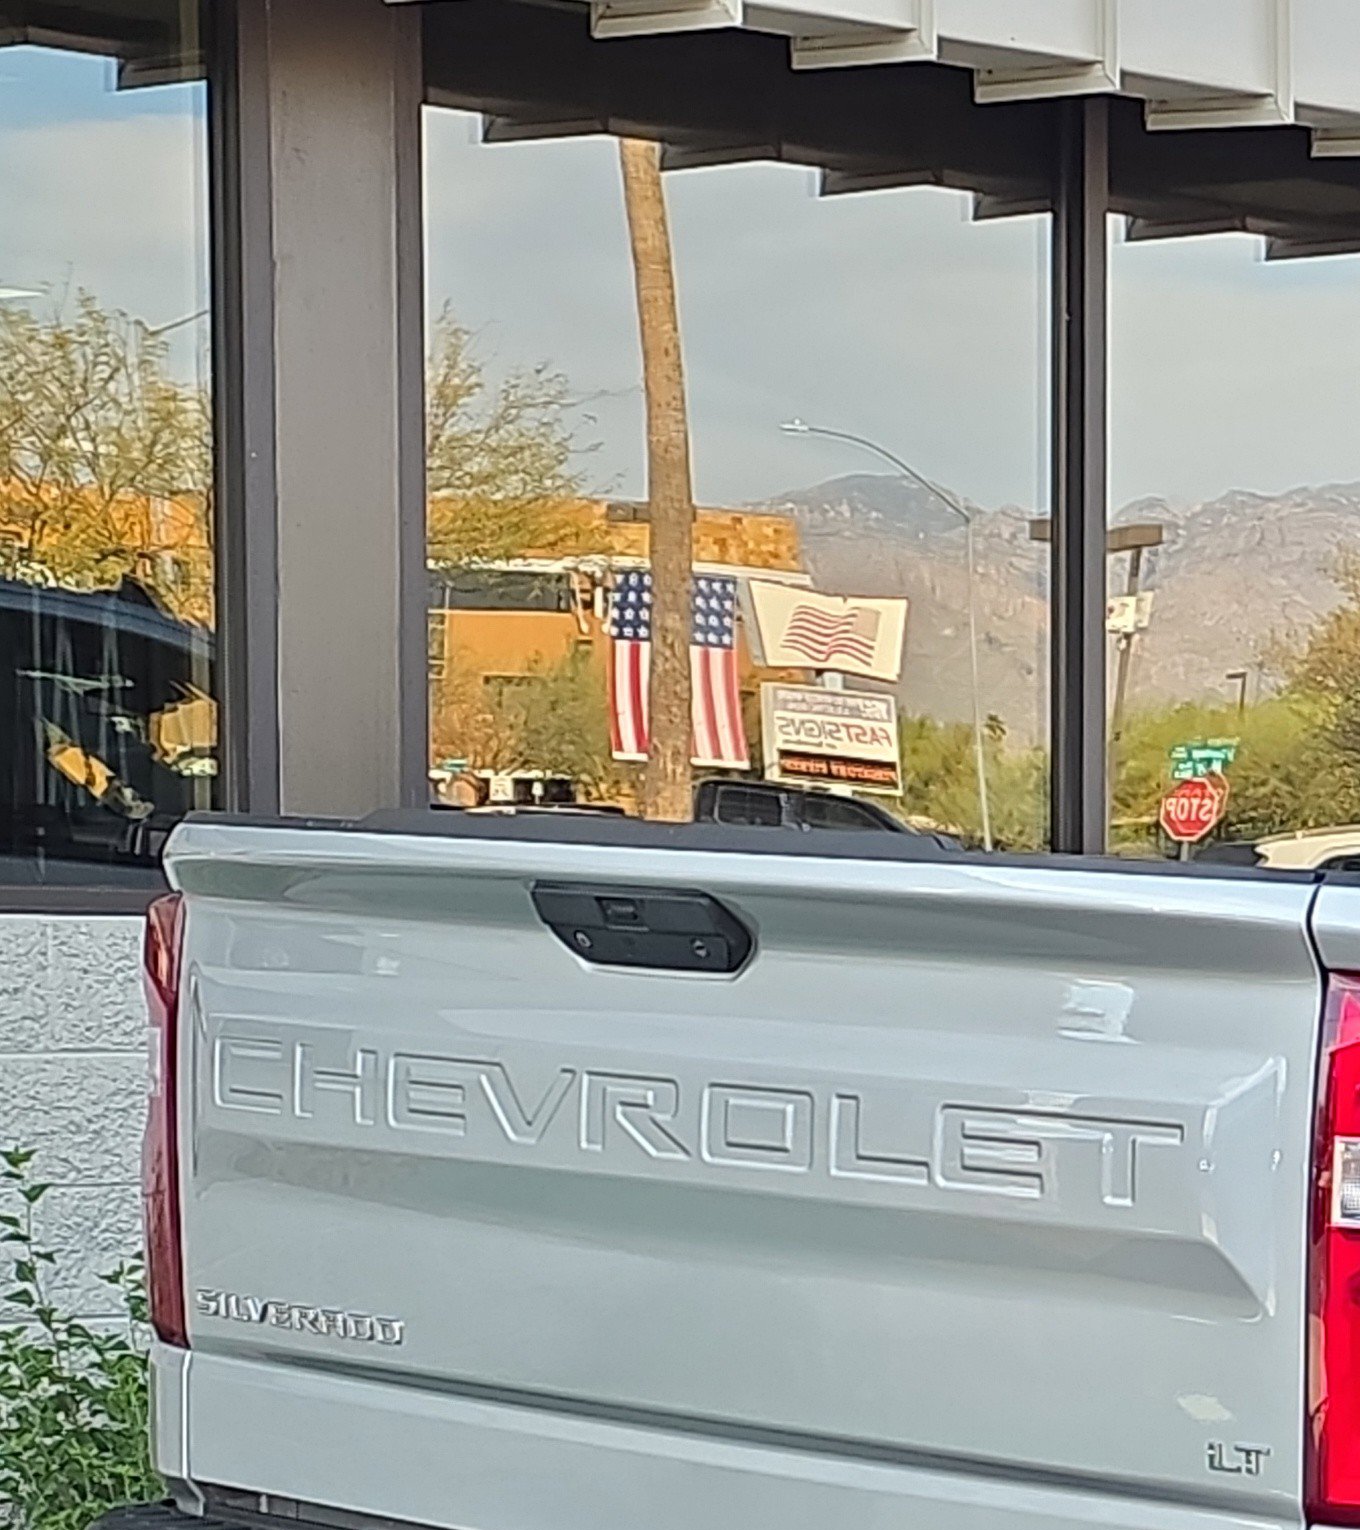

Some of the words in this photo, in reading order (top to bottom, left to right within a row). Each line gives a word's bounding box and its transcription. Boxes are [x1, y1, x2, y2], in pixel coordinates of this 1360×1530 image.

[213, 1035, 1185, 1206] CHEVROLET
[196, 1287, 405, 1345] SILVERADO
[1207, 1441, 1271, 1476] LT
